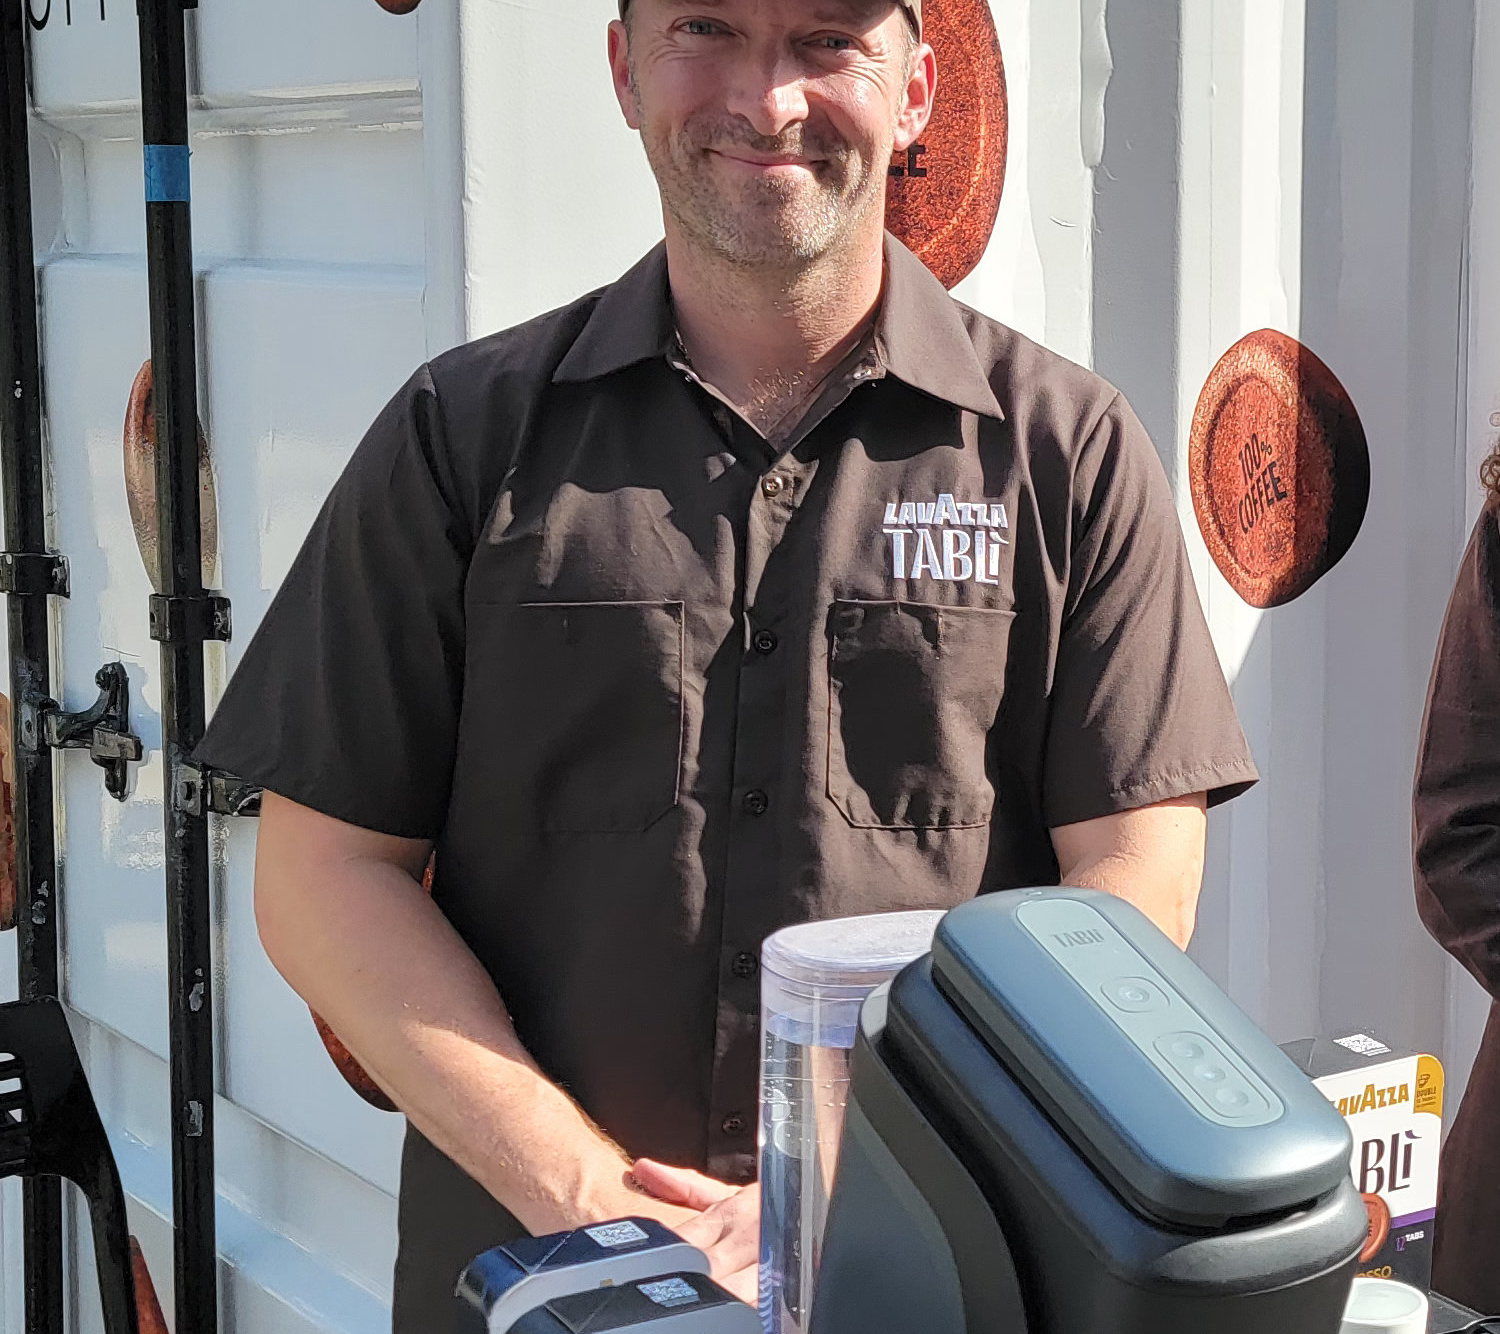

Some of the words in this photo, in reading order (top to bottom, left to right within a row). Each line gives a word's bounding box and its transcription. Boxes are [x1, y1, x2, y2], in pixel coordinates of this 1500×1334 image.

[1239, 433, 1273, 485] 100%
[883, 493, 1009, 528] LAVAZZA
[1239, 461, 1288, 533] COFFEE
[1332, 1083, 1409, 1117] AVAZZA
[1405, 1230, 1425, 1242] TABS
